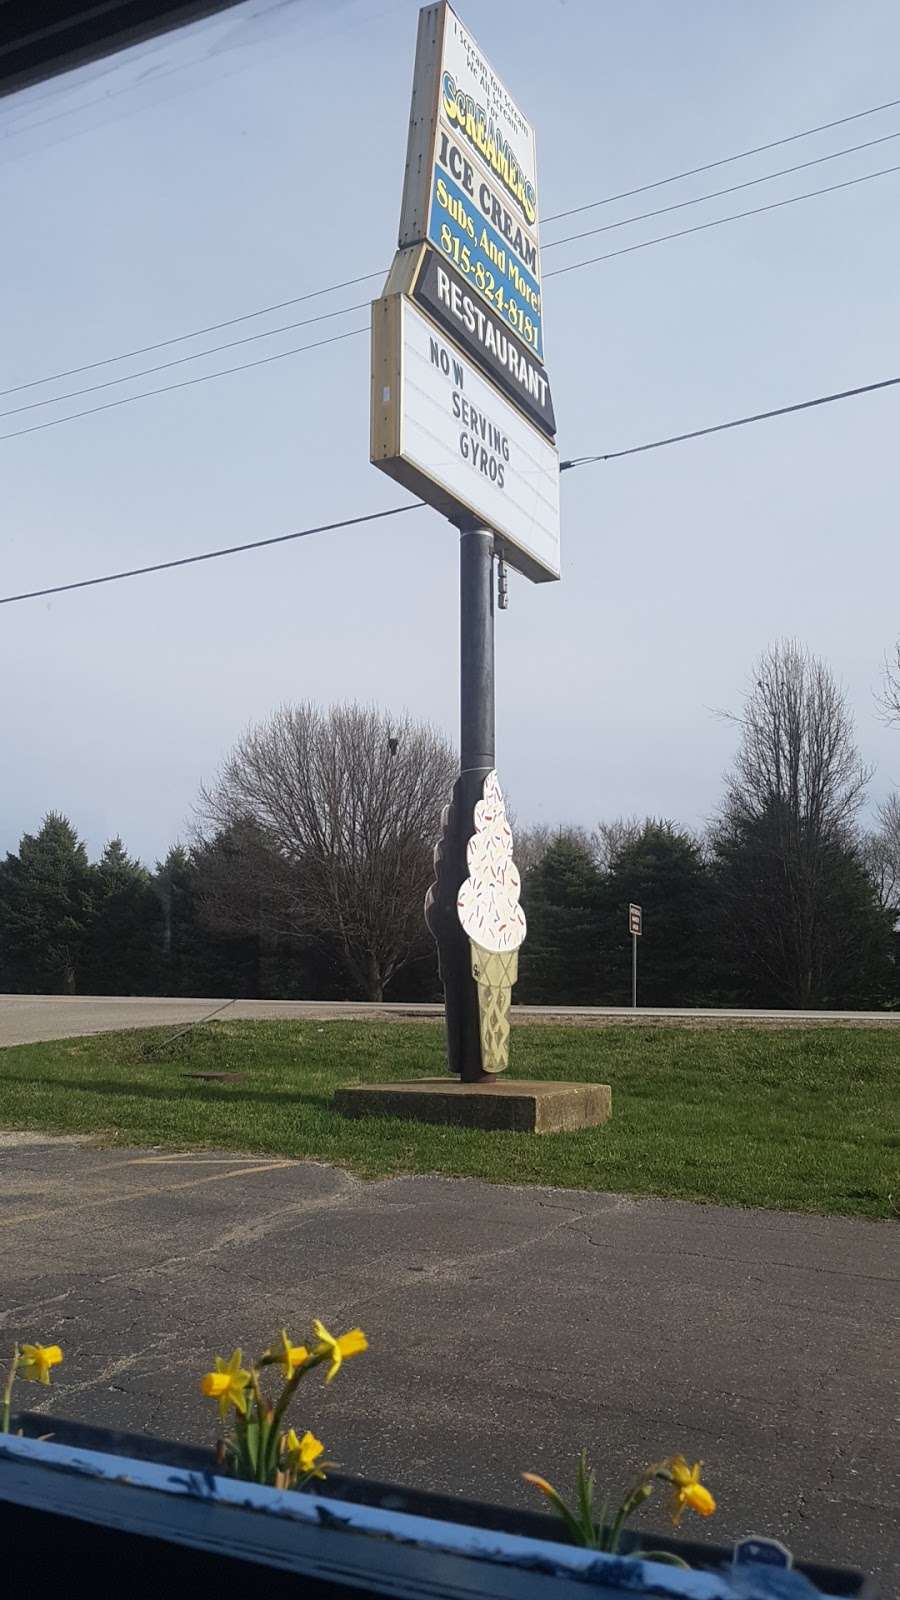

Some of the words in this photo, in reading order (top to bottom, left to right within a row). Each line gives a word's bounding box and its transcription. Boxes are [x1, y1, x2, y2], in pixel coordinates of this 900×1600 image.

[467, 55, 477, 78] We
[480, 76, 490, 95] All
[493, 92, 518, 134] Scream
[487, 99, 498, 120] For
[490, 73, 501, 98] You
[504, 95, 529, 137] Scream
[439, 132, 474, 197] ICE
[478, 183, 537, 276] CREAM
[436, 179, 477, 247] Subs,
[479, 227, 506, 275] And
[508, 258, 541, 316] More!
[440, 223, 538, 350] 815-824-8181
[437, 266, 548, 407] RESTAURANT
[452, 392, 510, 463] SERVING
[459, 431, 505, 490] GYROS
